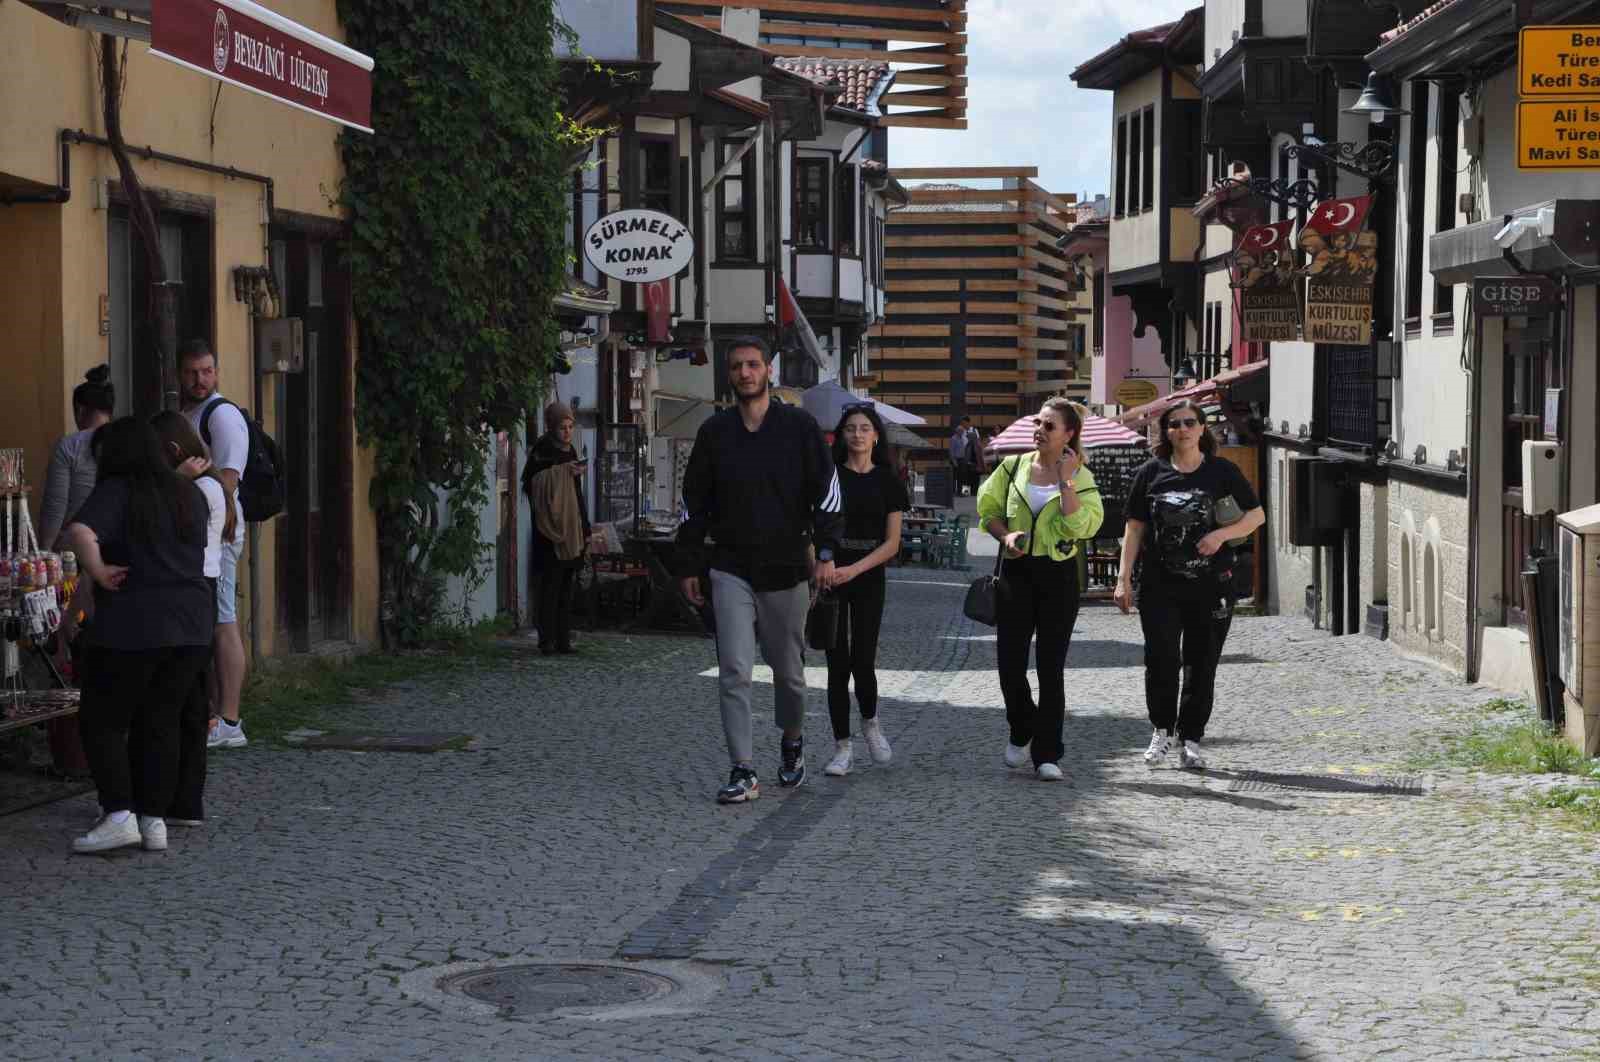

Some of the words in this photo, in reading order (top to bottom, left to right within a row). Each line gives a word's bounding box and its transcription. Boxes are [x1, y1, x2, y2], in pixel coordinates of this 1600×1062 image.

[234, 31, 264, 72] BEYAZ
[265, 37, 285, 81] İNCİ
[290, 50, 328, 105] LÜLETAŞI
[1531, 73, 1572, 87] Kedi
[1553, 109, 1577, 122] Ali
[1584, 106, 1600, 122] İs
[1556, 128, 1600, 141] Türe
[1529, 147, 1570, 161] Mavi
[590, 217, 686, 249] SÜRMELİ
[606, 245, 672, 263] KONAK
[625, 266, 648, 276] 1795
[1481, 282, 1541, 305] GİŞE
[1309, 304, 1370, 323] KURTULUŞ
[1312, 322, 1362, 341] MÜZESİ
